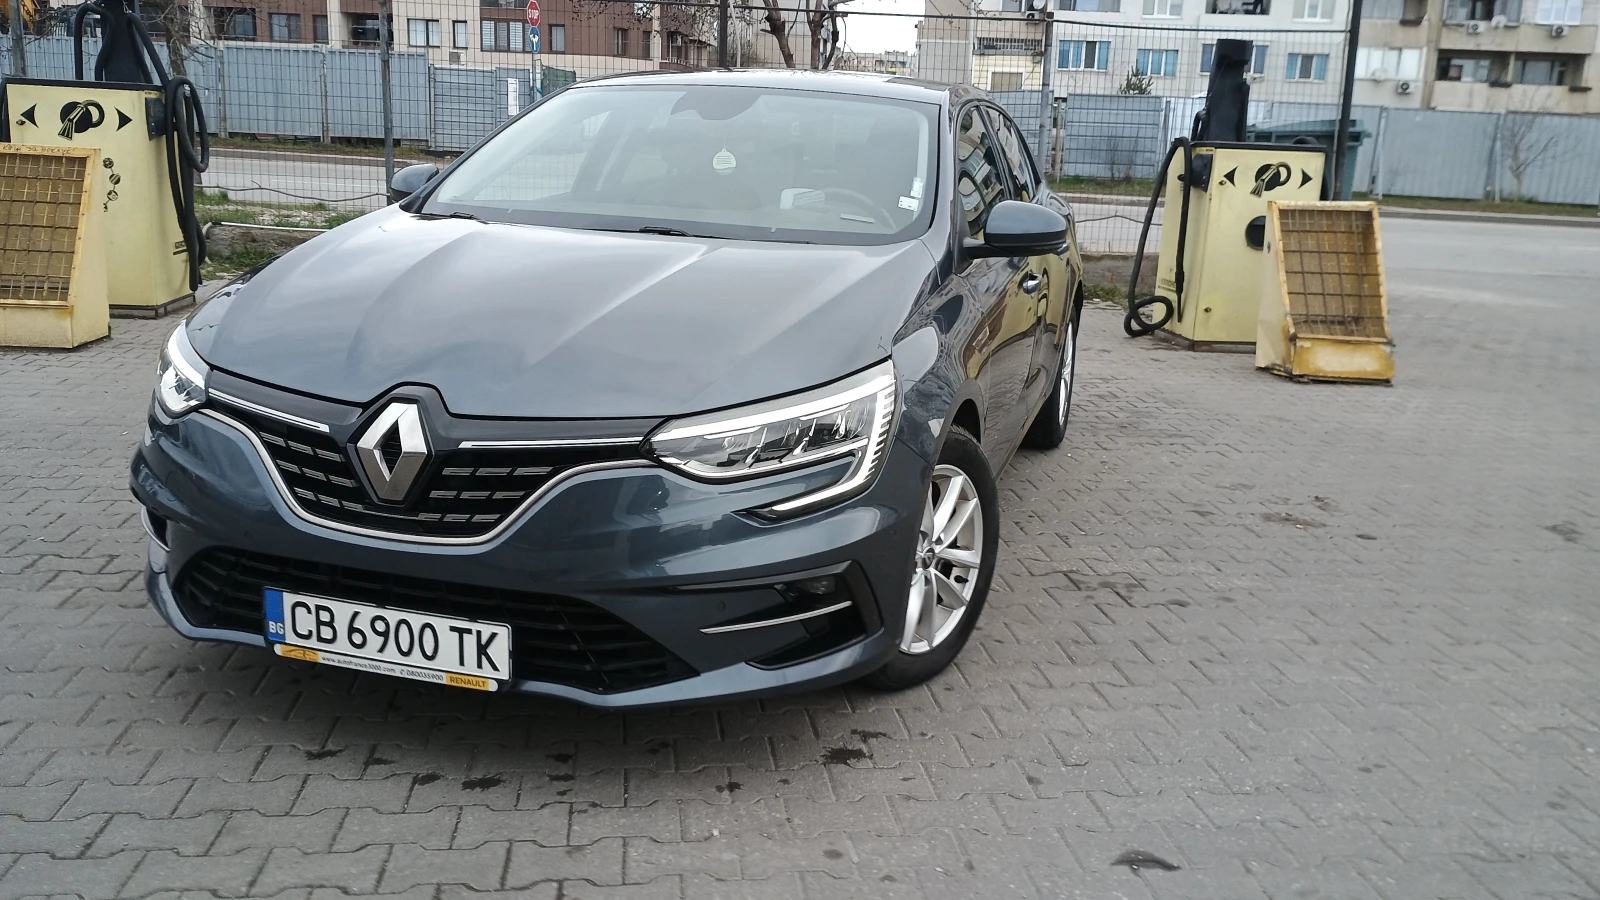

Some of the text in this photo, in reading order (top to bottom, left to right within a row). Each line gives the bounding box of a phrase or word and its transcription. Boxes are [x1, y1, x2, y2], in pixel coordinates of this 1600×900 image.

[528, 9, 539, 19] STOP
[268, 621, 285, 635] BG
[290, 600, 501, 672] CB 6900 TK
[449, 675, 486, 688] RENAULT
